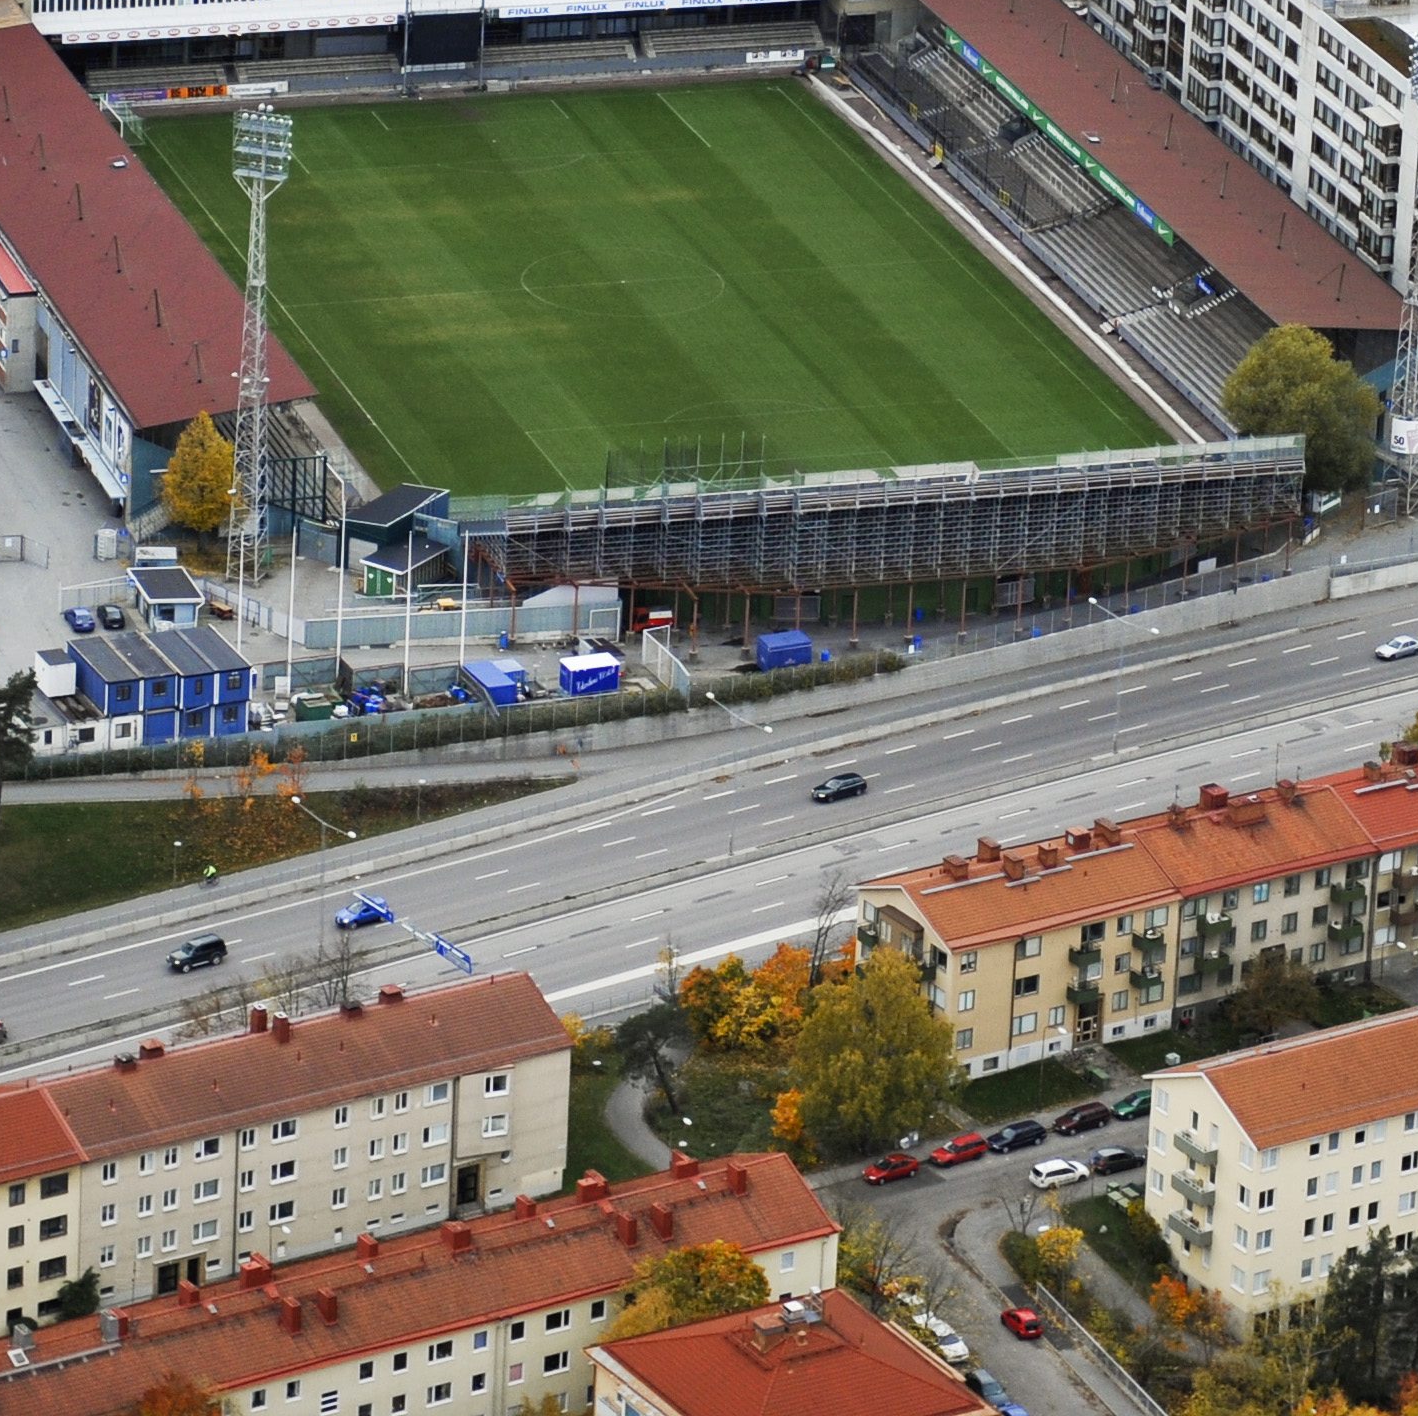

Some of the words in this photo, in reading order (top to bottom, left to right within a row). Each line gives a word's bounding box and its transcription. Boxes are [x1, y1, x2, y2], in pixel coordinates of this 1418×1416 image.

[507, 7, 550, 16] FINLUX
[566, 3, 608, 12] FINLUX
[624, 0, 666, 9] FINLUX
